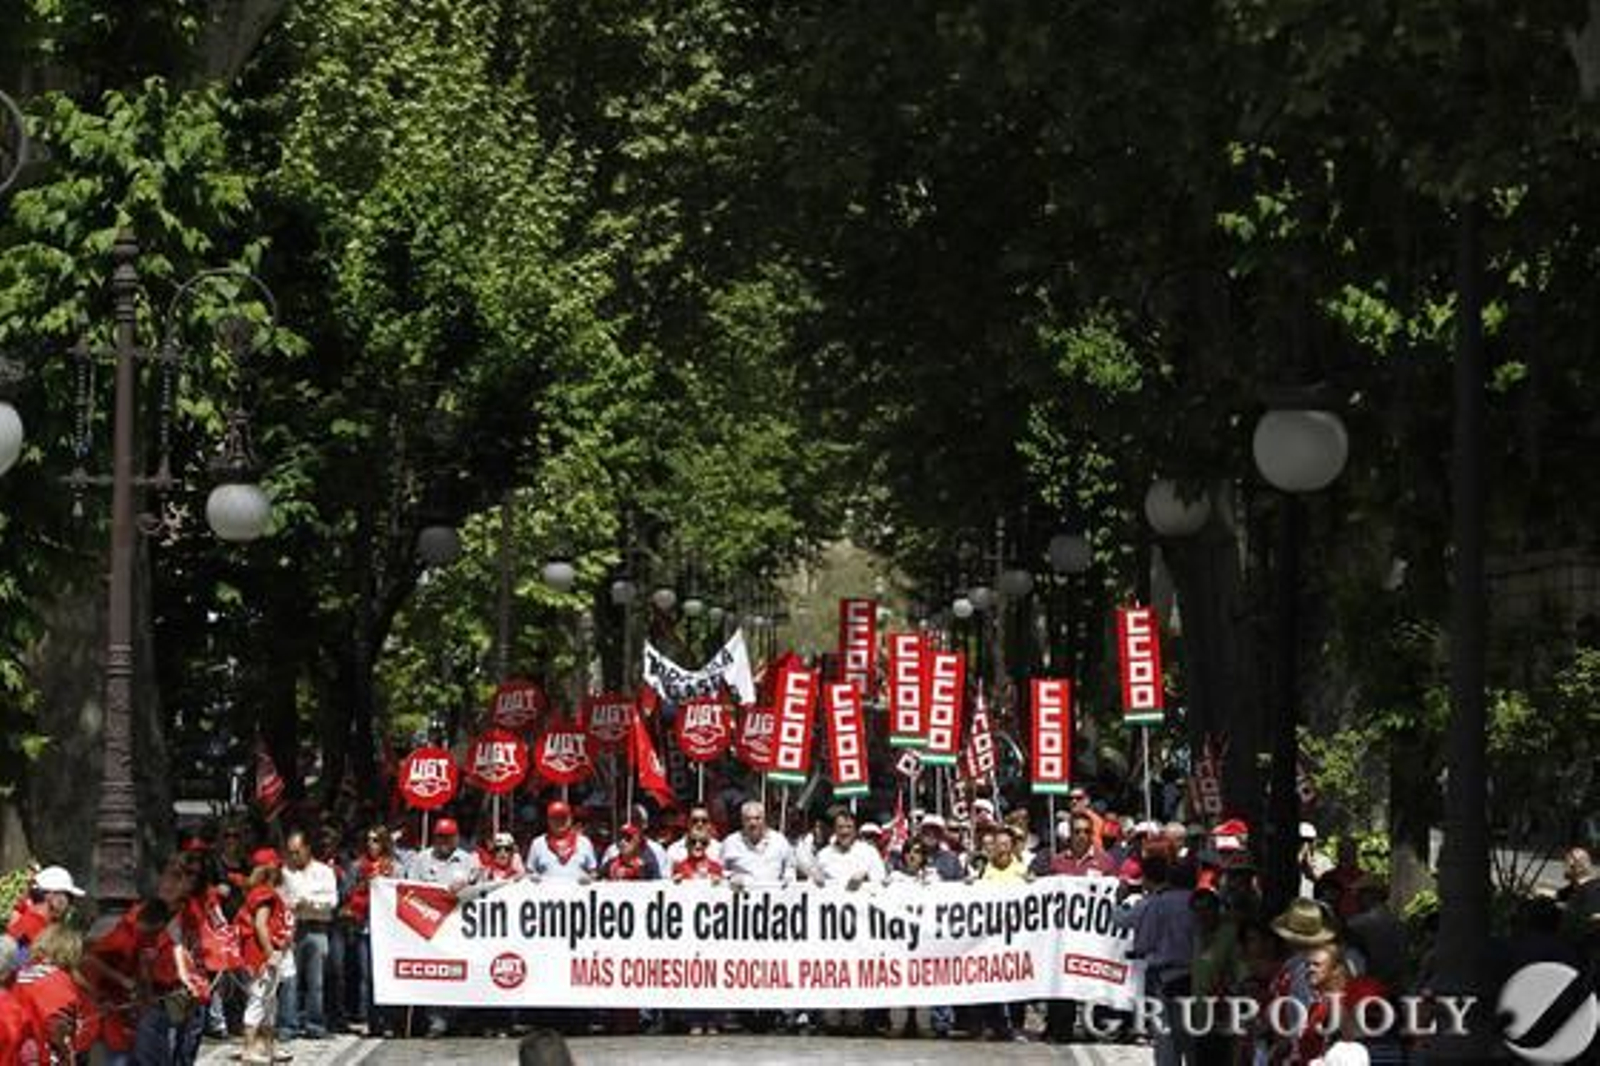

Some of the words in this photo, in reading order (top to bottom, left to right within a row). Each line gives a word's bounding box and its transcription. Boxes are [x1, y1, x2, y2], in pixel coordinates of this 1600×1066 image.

[897, 635, 920, 732] CCOO
[1126, 610, 1155, 709] CCOO
[591, 704, 631, 726] UGT
[684, 704, 722, 728] UGT
[744, 712, 775, 736] UG
[777, 672, 810, 769] CCOO
[929, 655, 957, 750] CCOO
[475, 742, 517, 765] UGT
[544, 733, 585, 757] UGT
[832, 684, 861, 782] CCOO
[1038, 681, 1063, 778] CCOO
[410, 759, 448, 780] UGT
[461, 890, 507, 939] sin
[520, 890, 635, 950] empleo
[645, 890, 683, 940] de
[694, 891, 808, 941] calidad
[820, 903, 857, 941] no
[570, 951, 614, 987] MÁS
[621, 951, 717, 988] COHESIÓN
[723, 958, 793, 989] SOCIAL
[800, 960, 852, 989] PARA
[858, 953, 901, 988] MÁS
[908, 951, 1034, 987] DEMOCRACIA
